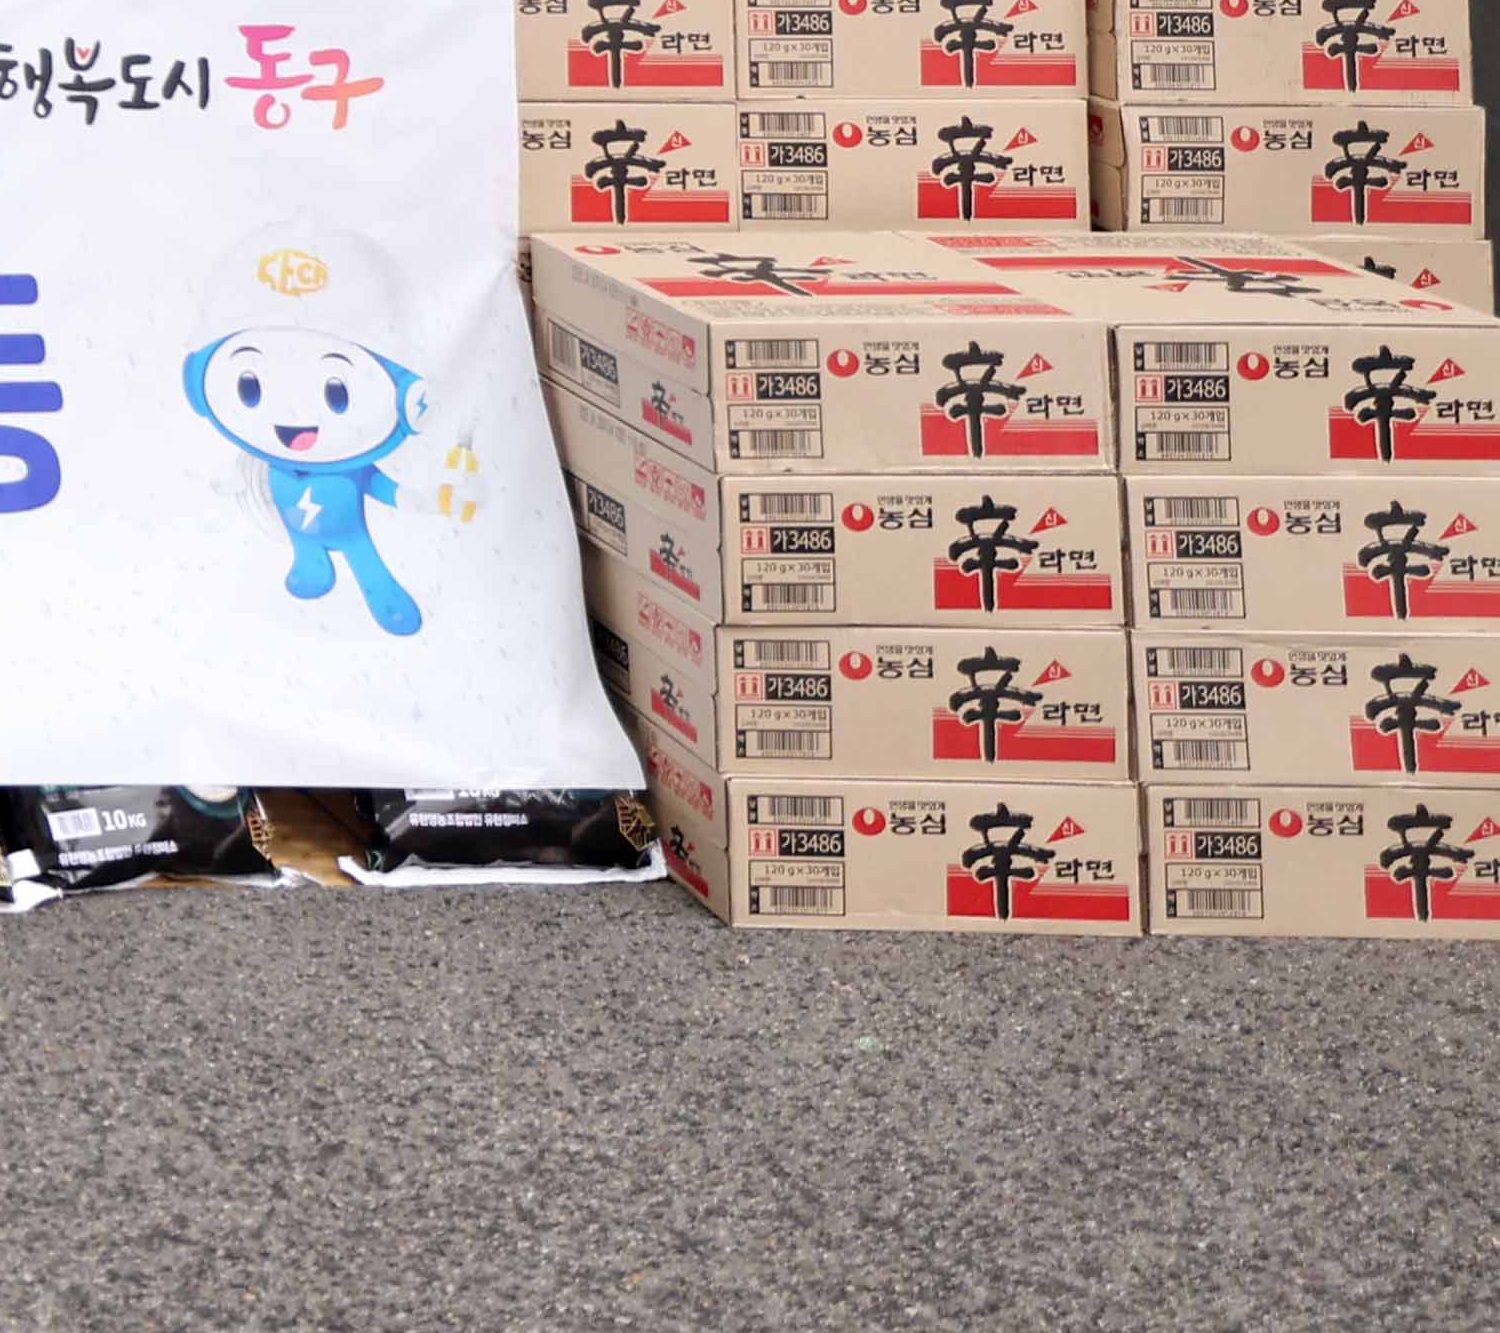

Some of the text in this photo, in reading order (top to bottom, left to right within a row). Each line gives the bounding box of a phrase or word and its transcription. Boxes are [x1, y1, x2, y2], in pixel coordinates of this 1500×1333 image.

[1159, 14, 1211, 34] 가3486
[1395, 35, 1448, 57] 라면
[224, 25, 384, 130] 동구
[521, 130, 572, 150] 농심
[586, 121, 718, 224] 辛 라면
[863, 353, 921, 376] 농심
[759, 374, 817, 397] 가3486
[937, 342, 1085, 457] 辛 라면
[888, 813, 947, 836] 농심
[781, 831, 841, 854] 가3486
[959, 803, 1116, 920] 辛 라면
